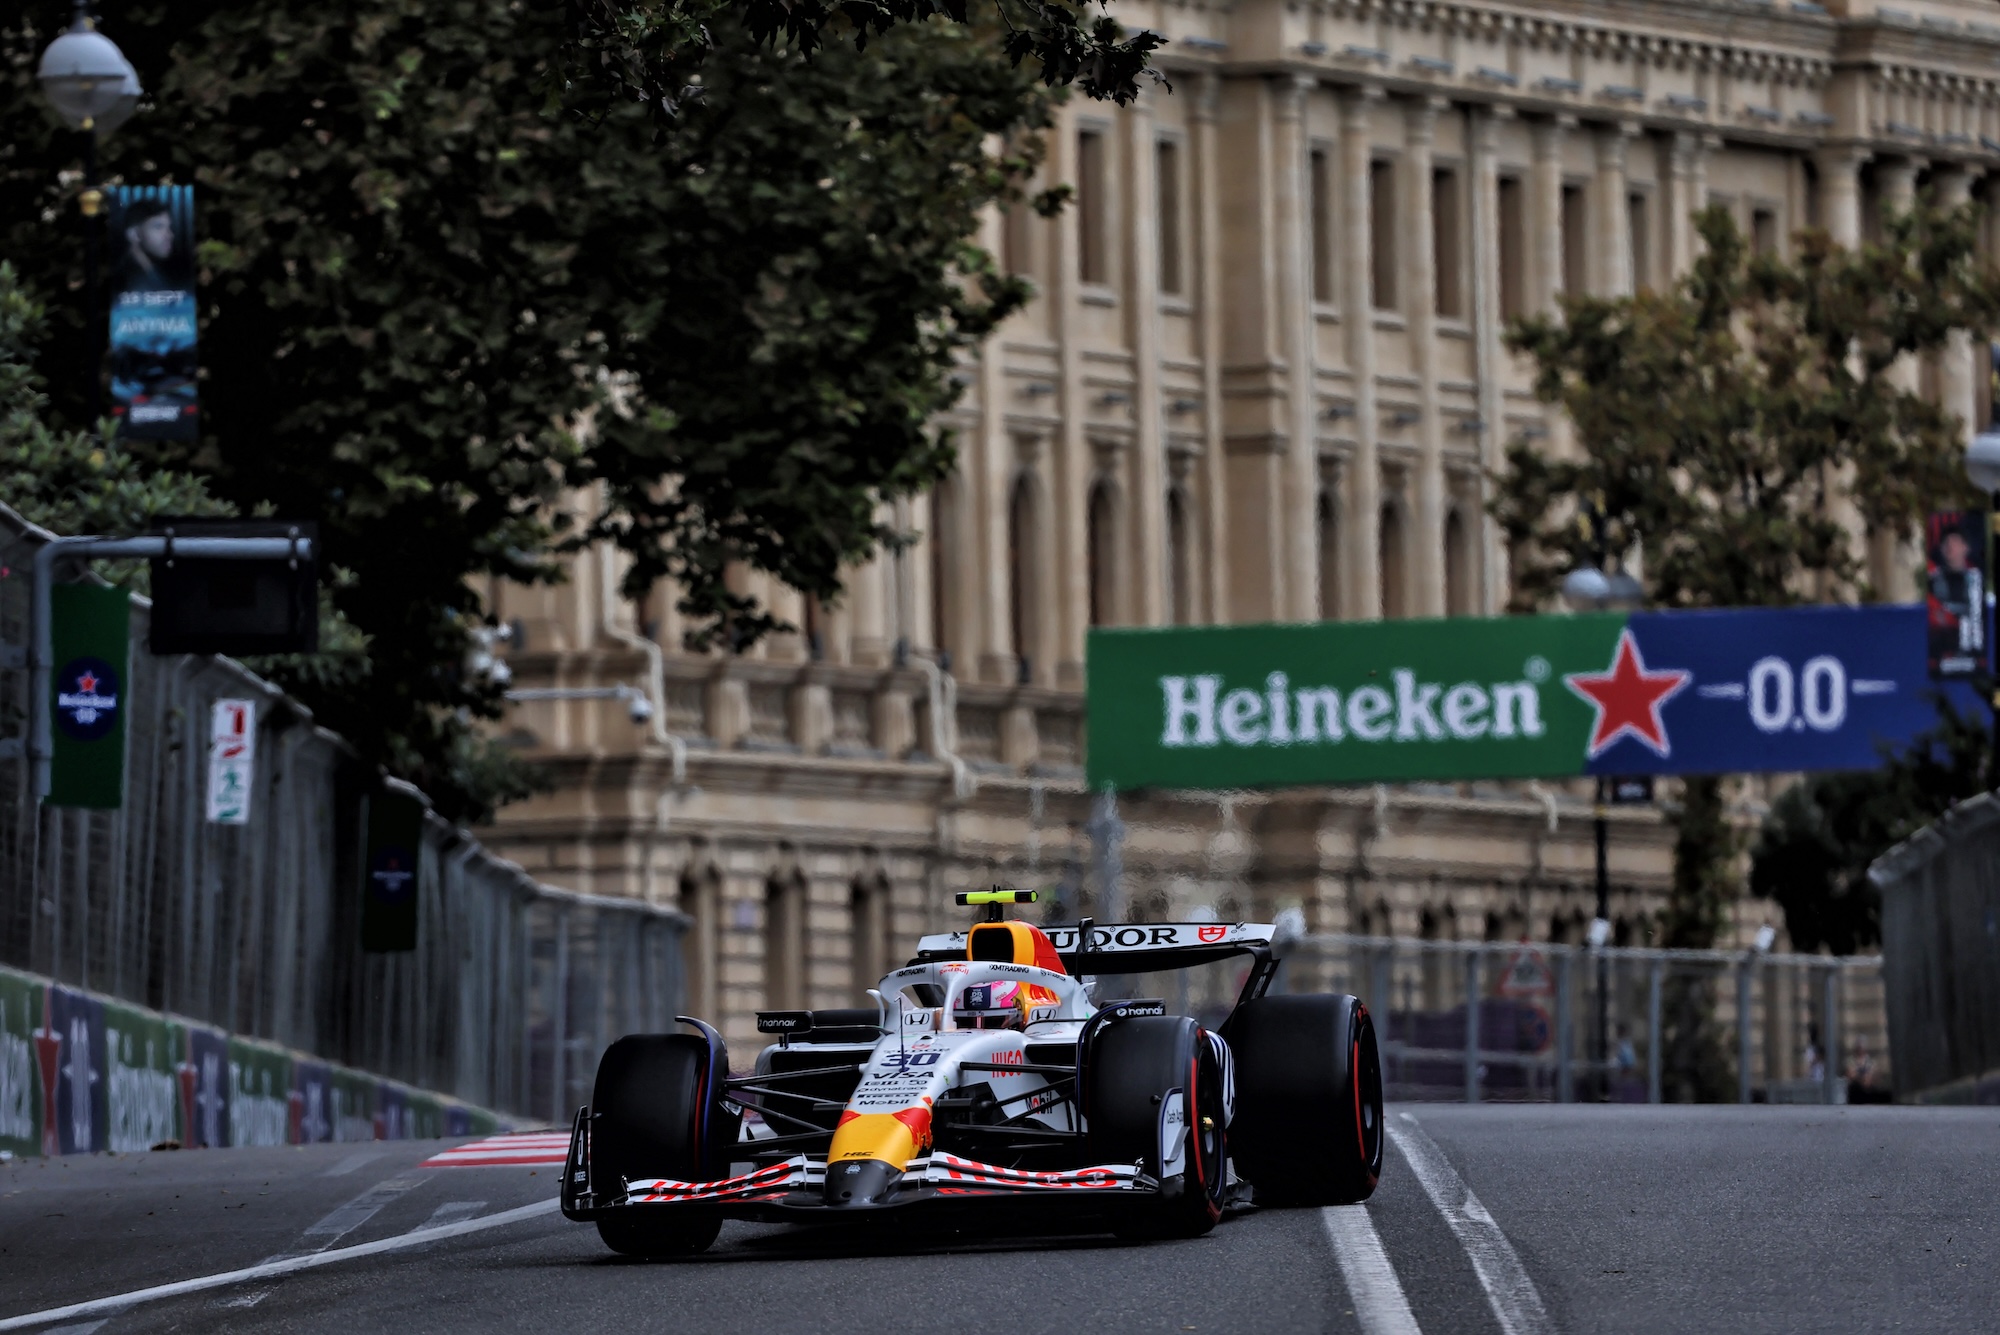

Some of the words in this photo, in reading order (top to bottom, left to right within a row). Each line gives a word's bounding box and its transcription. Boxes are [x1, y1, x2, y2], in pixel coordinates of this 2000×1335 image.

[1159, 666, 1547, 747] Heineken
[1046, 927, 1180, 949] UDOR
[880, 1052, 941, 1067] 30
[991, 1049, 1023, 1078] HUGO
[871, 1071, 934, 1080] VISA
